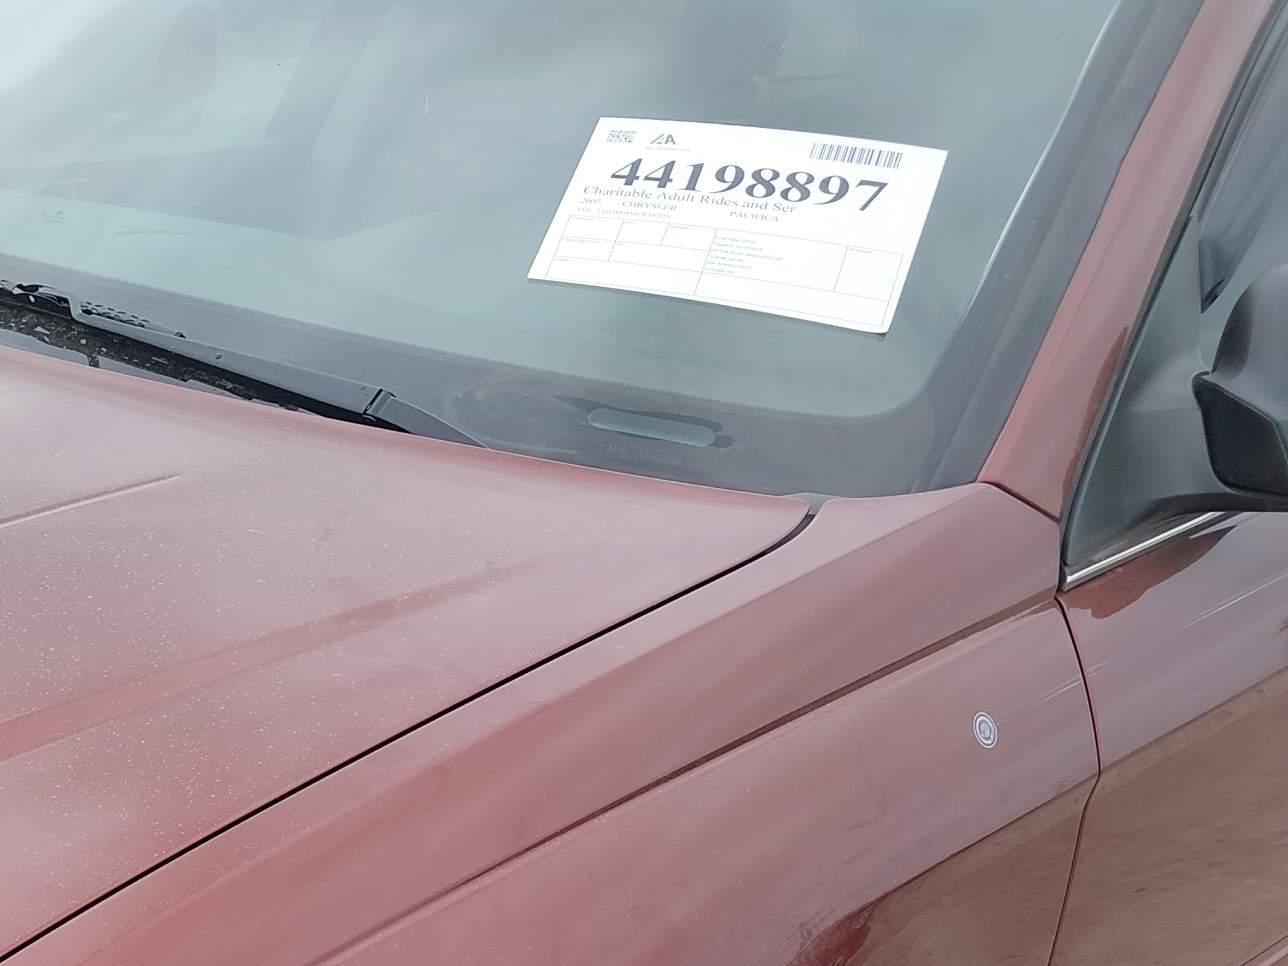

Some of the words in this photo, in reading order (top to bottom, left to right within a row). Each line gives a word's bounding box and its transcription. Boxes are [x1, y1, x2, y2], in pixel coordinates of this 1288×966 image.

[611, 158, 888, 211] 44198897
[583, 186, 653, 199] Charitable
[657, 191, 695, 203] Adult
[700, 195, 738, 206] Rides
[742, 200, 768, 210] and
[772, 203, 797, 213] Ser
[622, 201, 678, 211] CHRYSLER
[729, 211, 780, 222] PACIFICA
